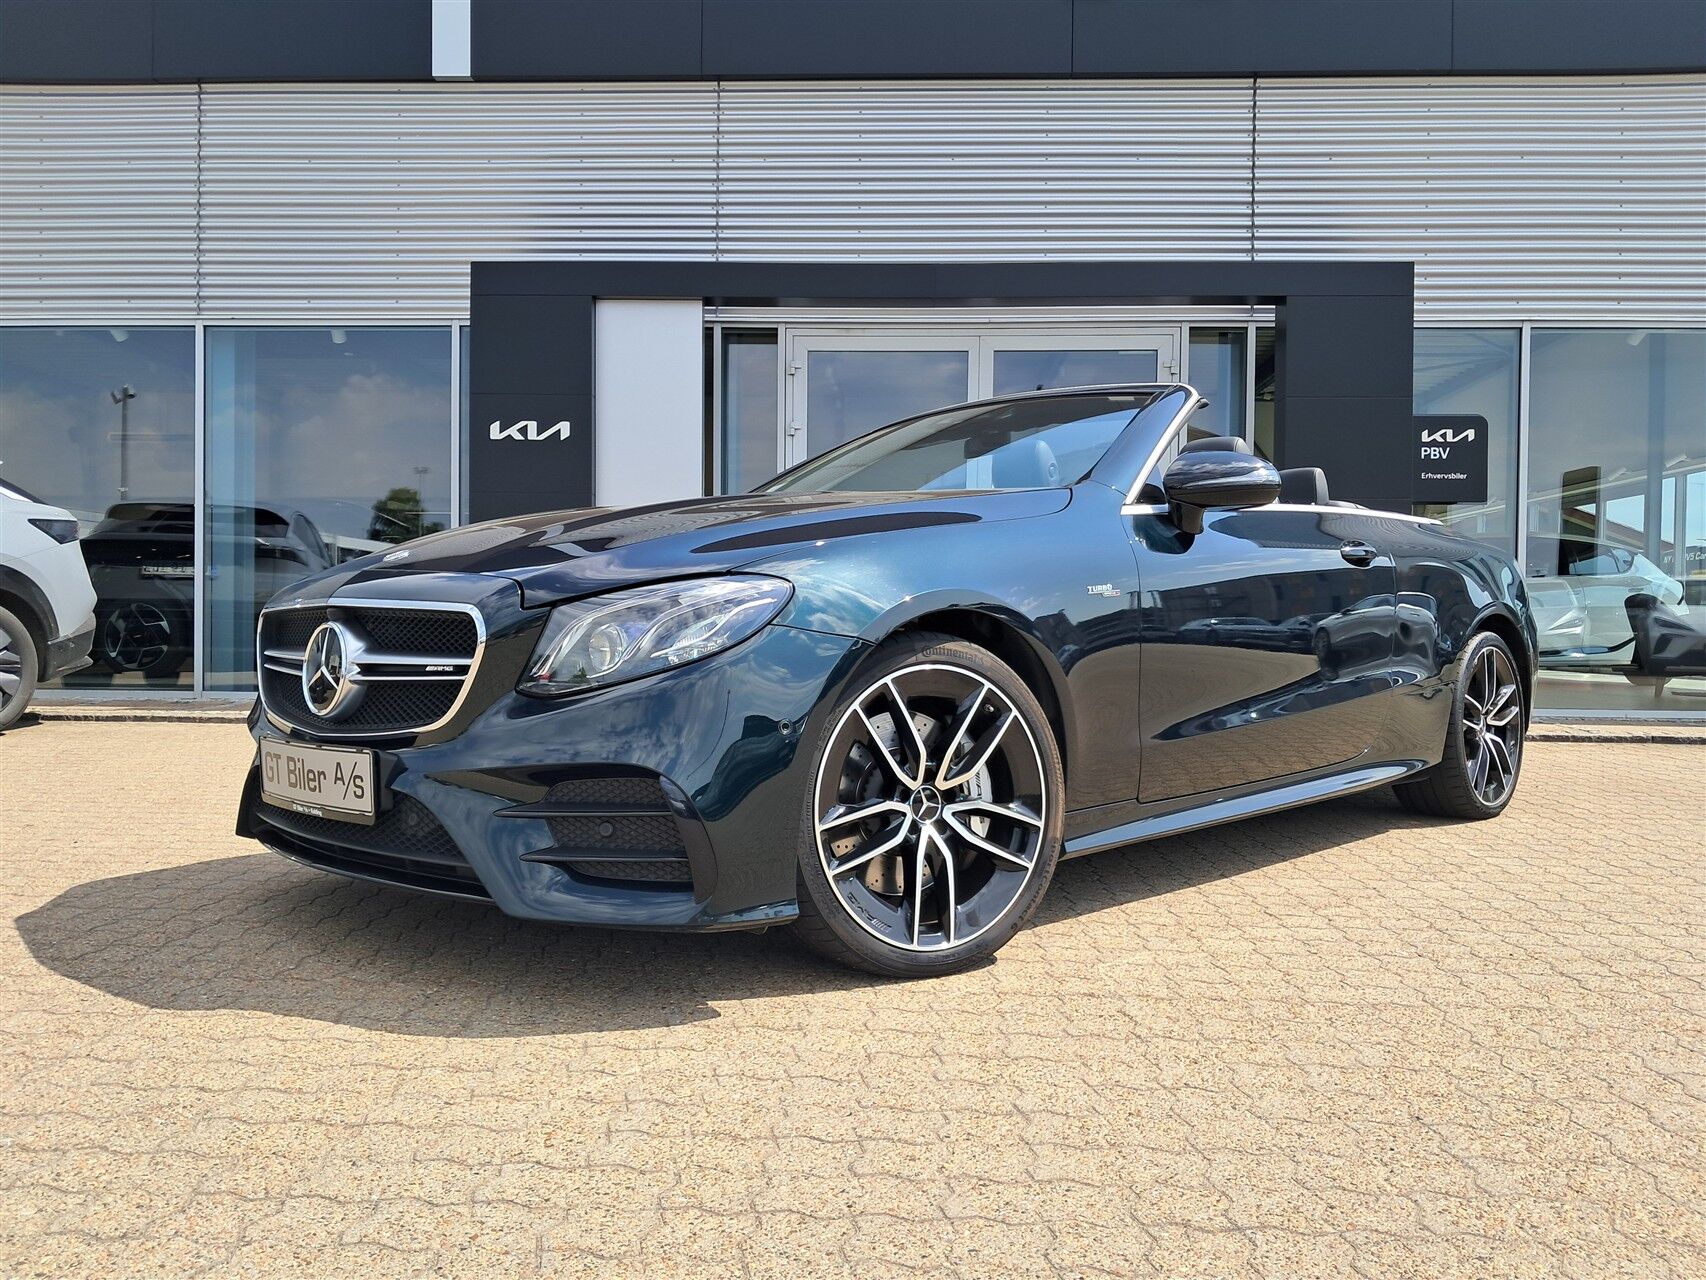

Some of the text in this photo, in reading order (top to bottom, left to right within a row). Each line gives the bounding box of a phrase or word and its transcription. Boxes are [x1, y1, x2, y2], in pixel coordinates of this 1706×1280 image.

[490, 420, 570, 441] KIA
[1421, 428, 1475, 442] KIA
[1421, 447, 1450, 460] PBV
[1087, 584, 1112, 594] TURBO
[922, 645, 980, 664] Continental
[264, 751, 281, 785] GT
[286, 755, 327, 793] Biler
